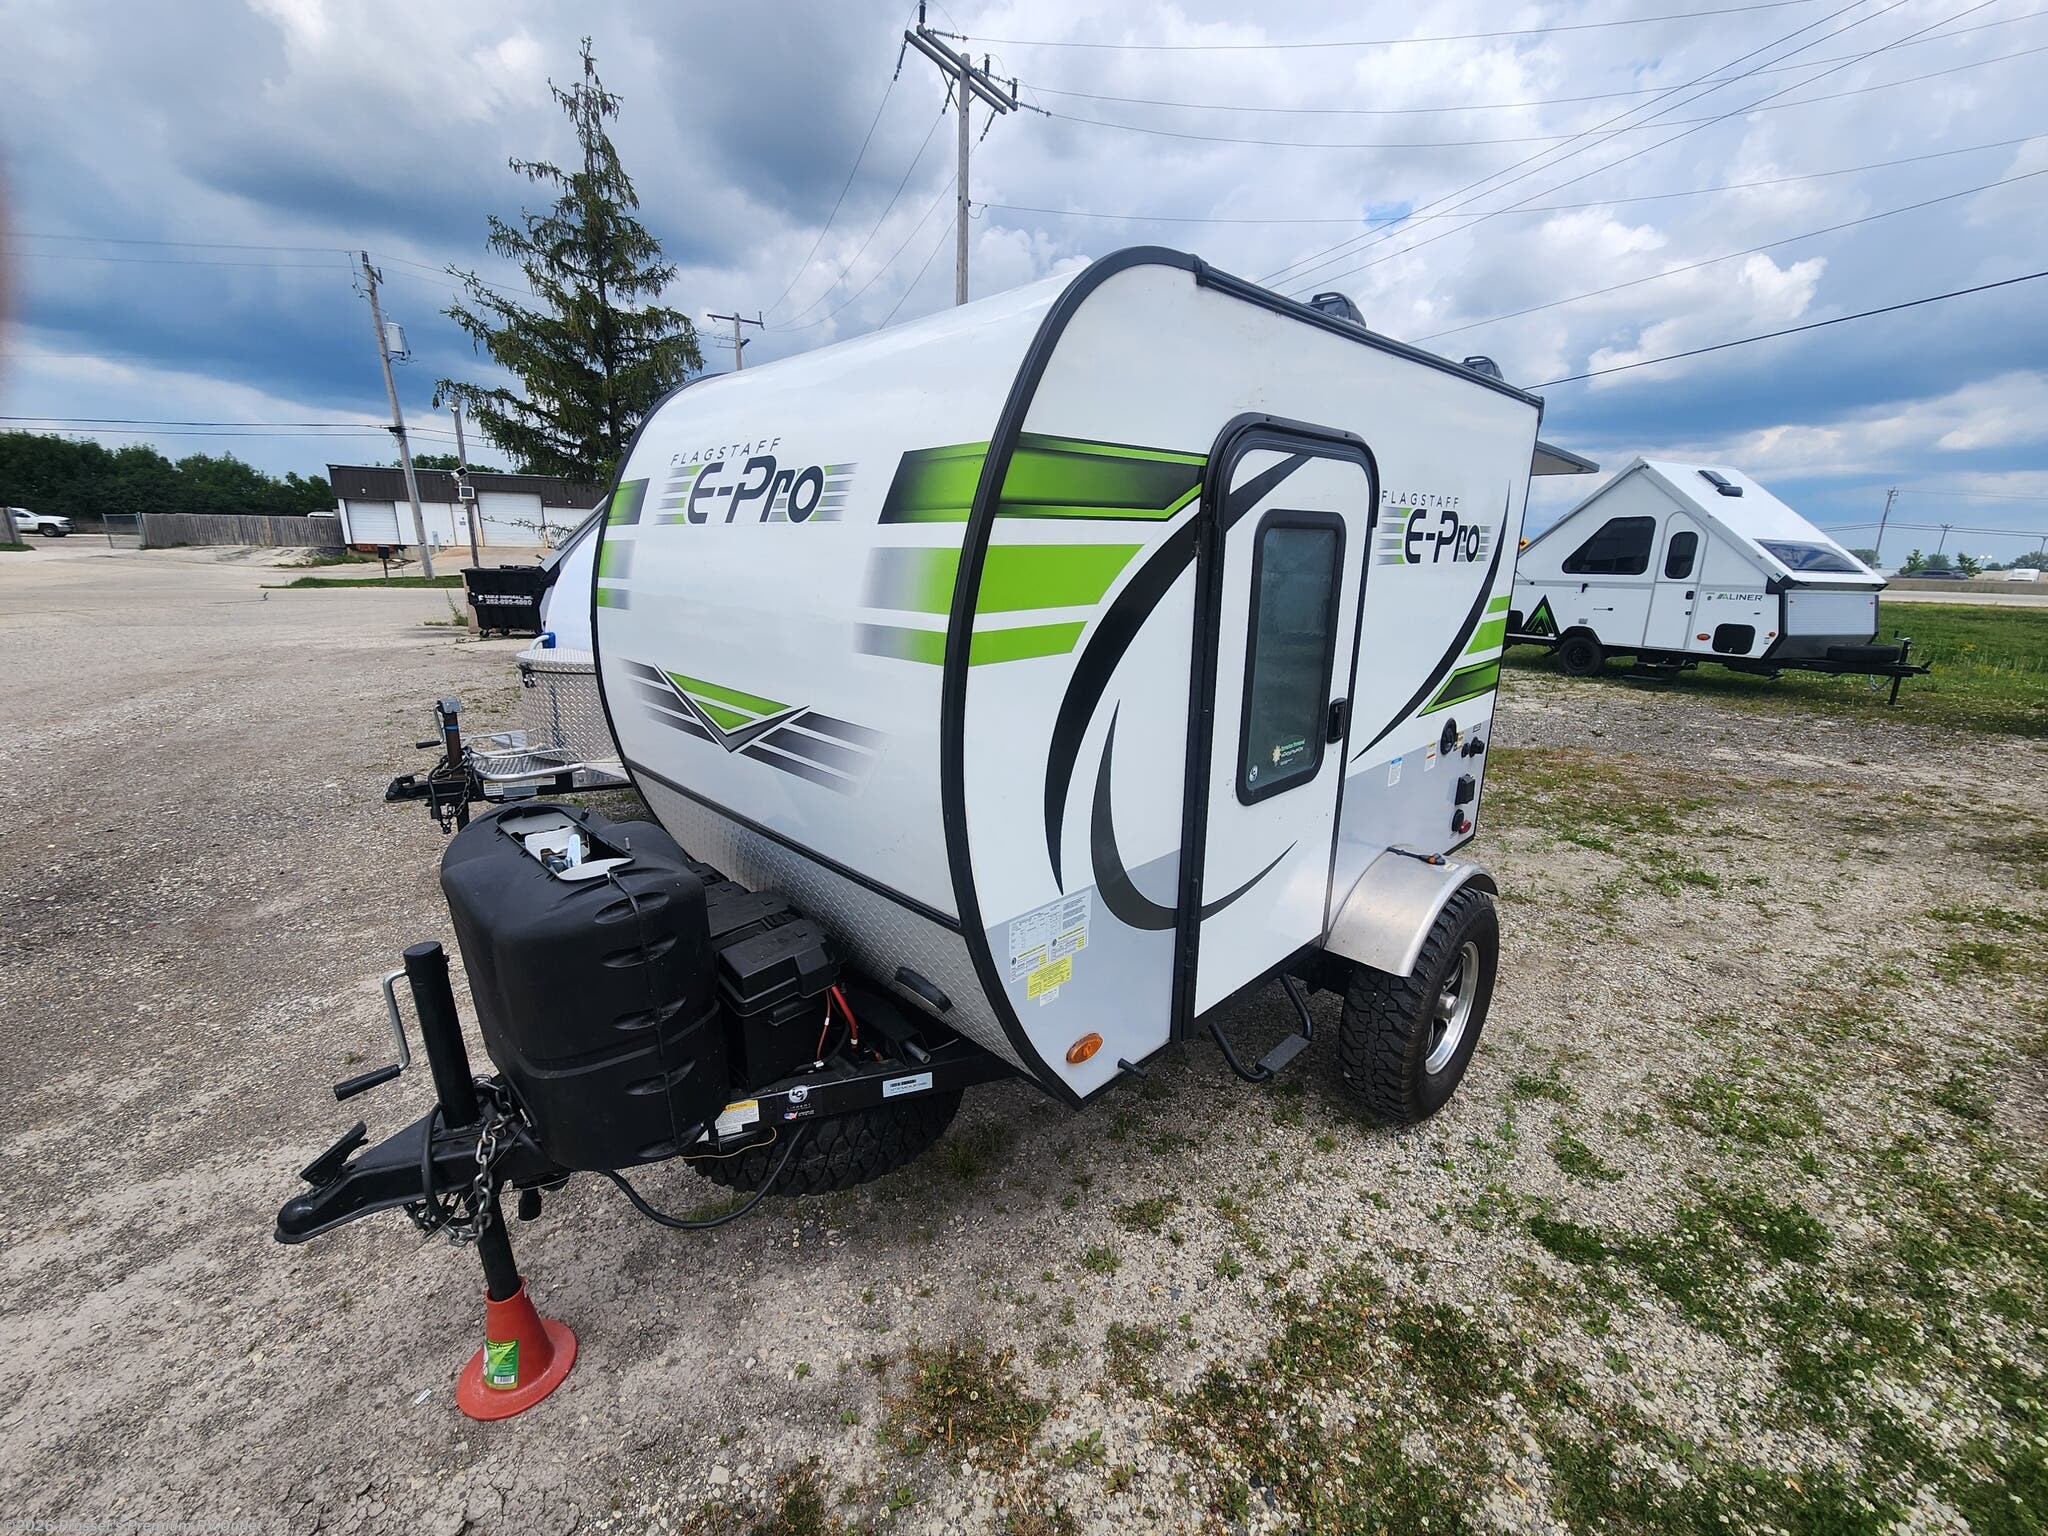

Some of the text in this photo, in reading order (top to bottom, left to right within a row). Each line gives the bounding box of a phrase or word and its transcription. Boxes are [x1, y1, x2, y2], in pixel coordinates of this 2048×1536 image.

[671, 437, 781, 466] FLAGSTAFF
[687, 455, 824, 524] E-Pro
[1381, 490, 1459, 508] FLAGSTAFF
[1405, 508, 1480, 564] E-Pro
